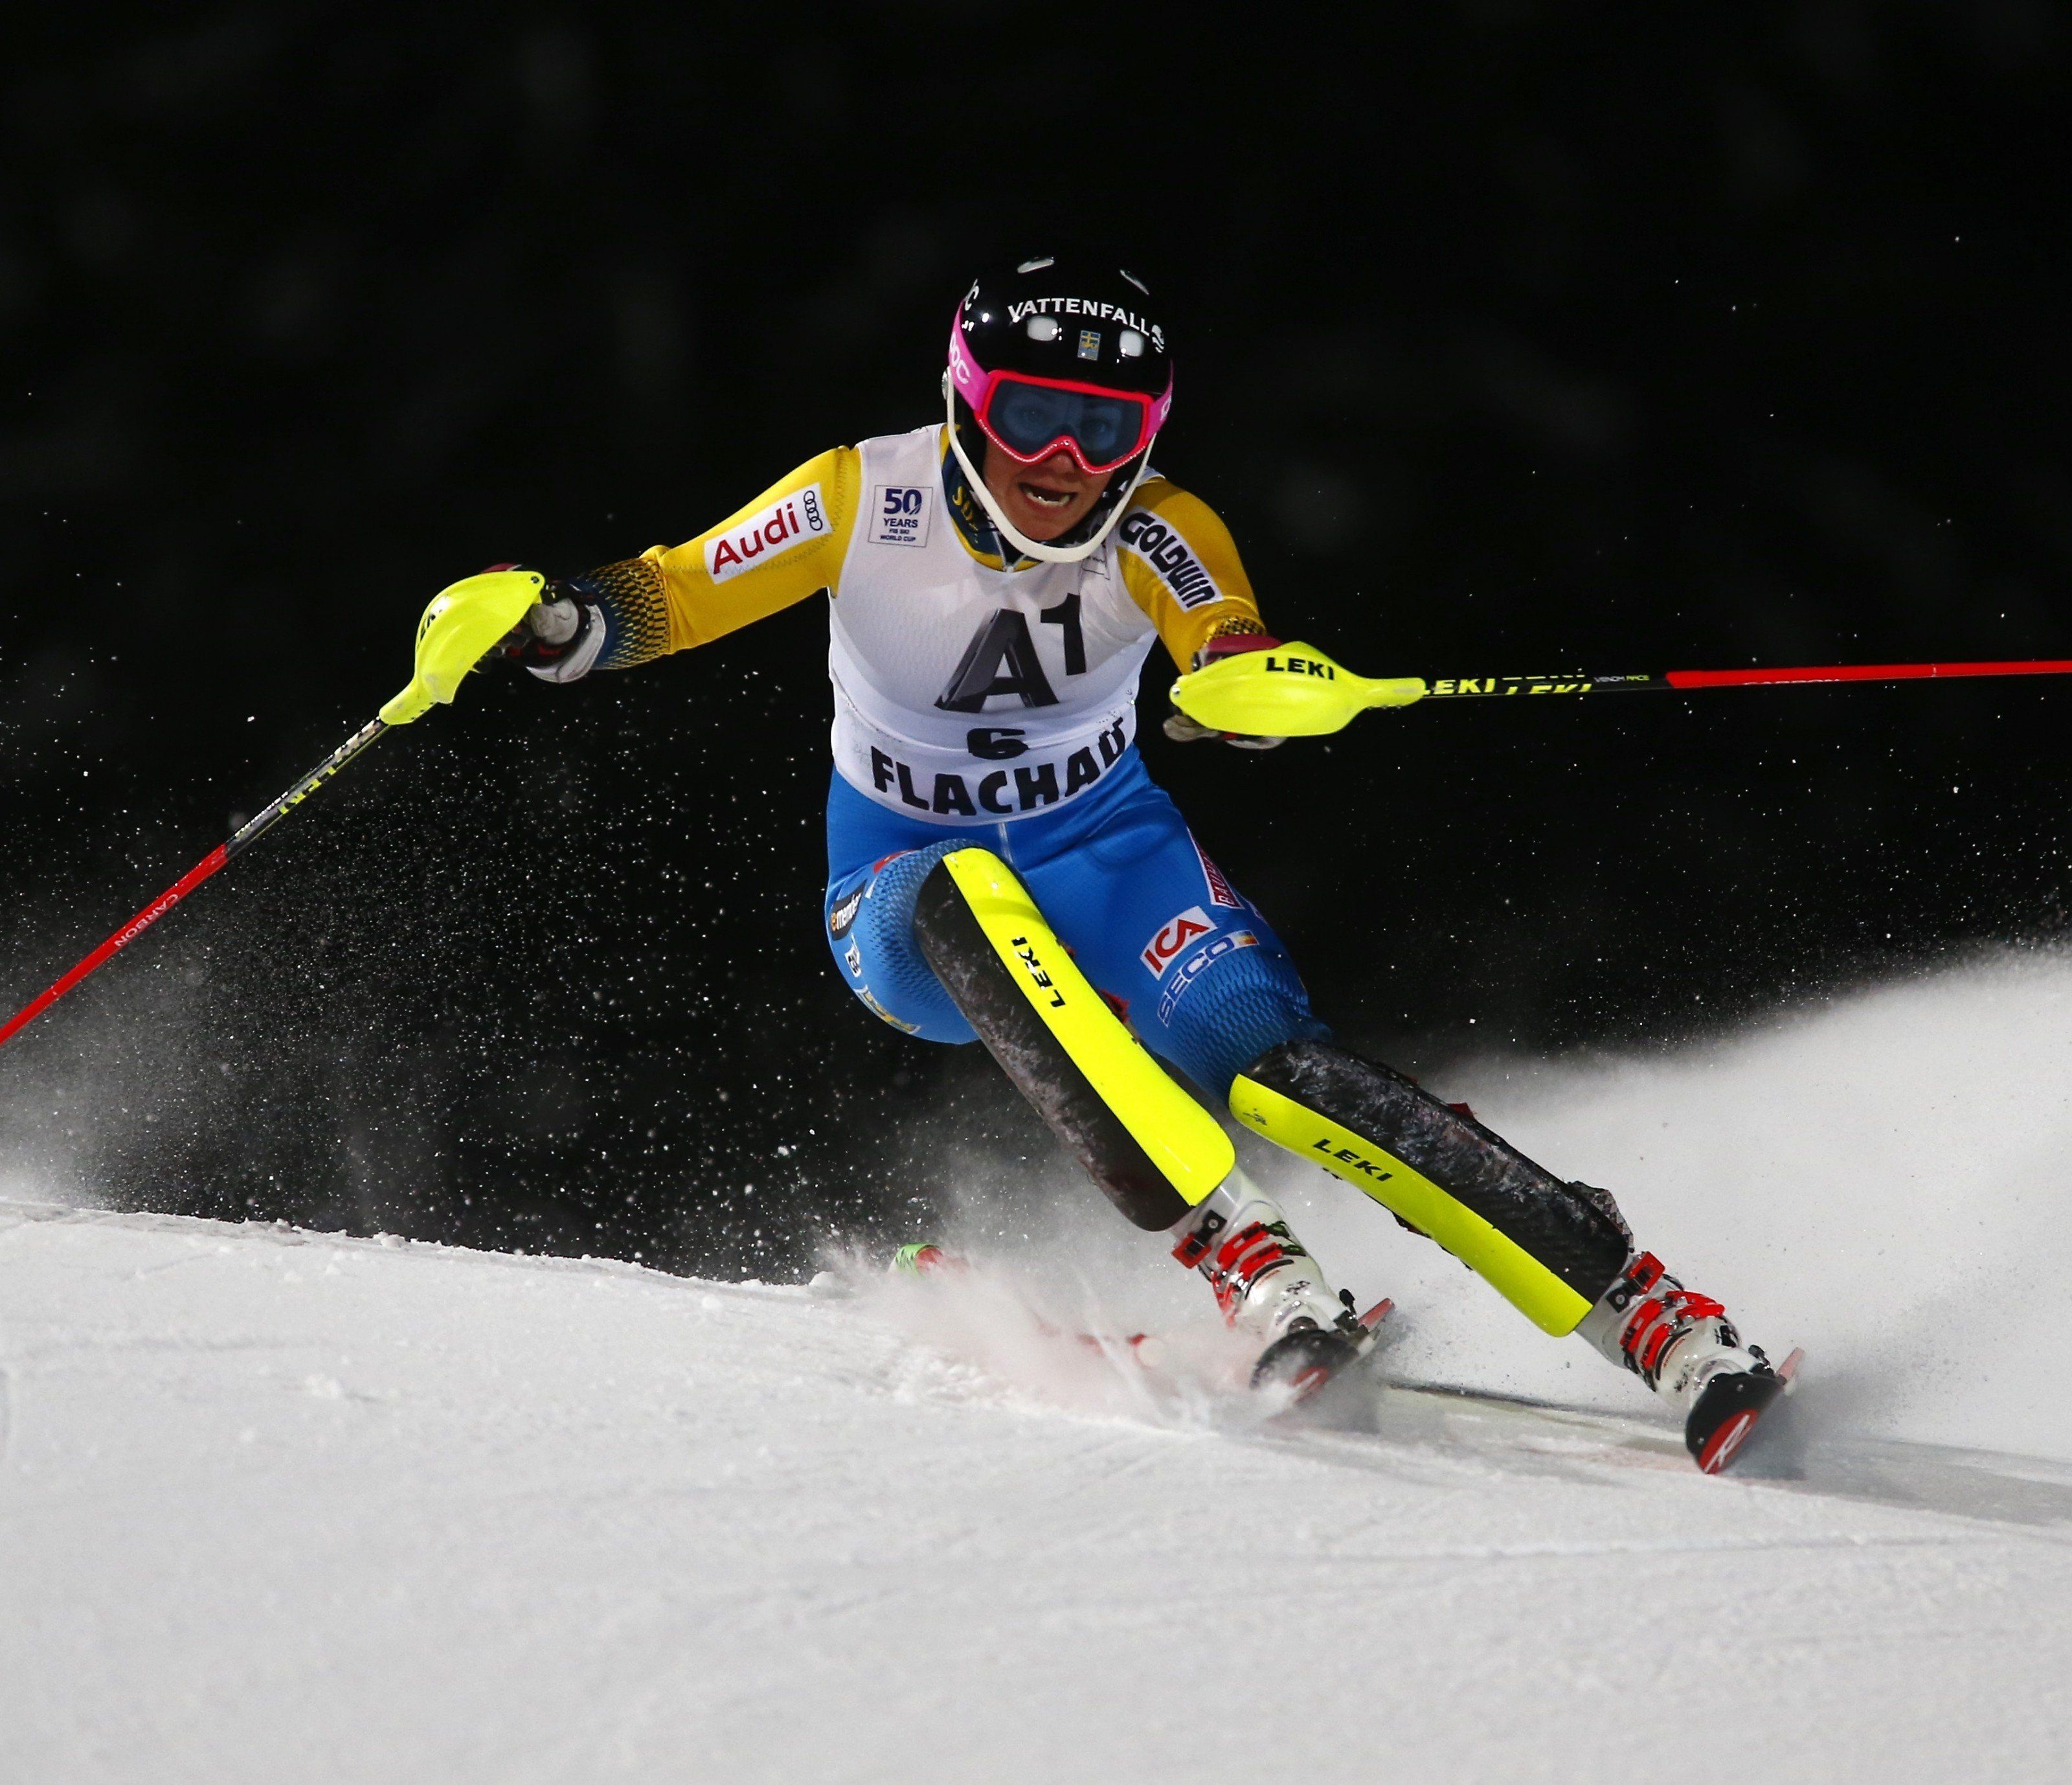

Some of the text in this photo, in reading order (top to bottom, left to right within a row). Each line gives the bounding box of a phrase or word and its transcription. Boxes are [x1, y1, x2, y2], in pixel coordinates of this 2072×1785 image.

[1008, 297, 1151, 337] VATTENFALL
[883, 517, 918, 528] YEARS
[884, 488, 922, 515] 50
[713, 502, 800, 575] Audi
[1120, 512, 1215, 608] GOLDWIN
[934, 593, 1087, 713] A1
[1266, 657, 1334, 681] LEKI
[871, 717, 1125, 816] FLACHAU
[967, 728, 1030, 760] 6
[114, 894, 178, 946] CARBON
[1144, 918, 1210, 973] ICA
[1011, 937, 1066, 1008] LEKI
[1157, 937, 1235, 1027] SECO
[1312, 1138, 1393, 1182] LEKI
